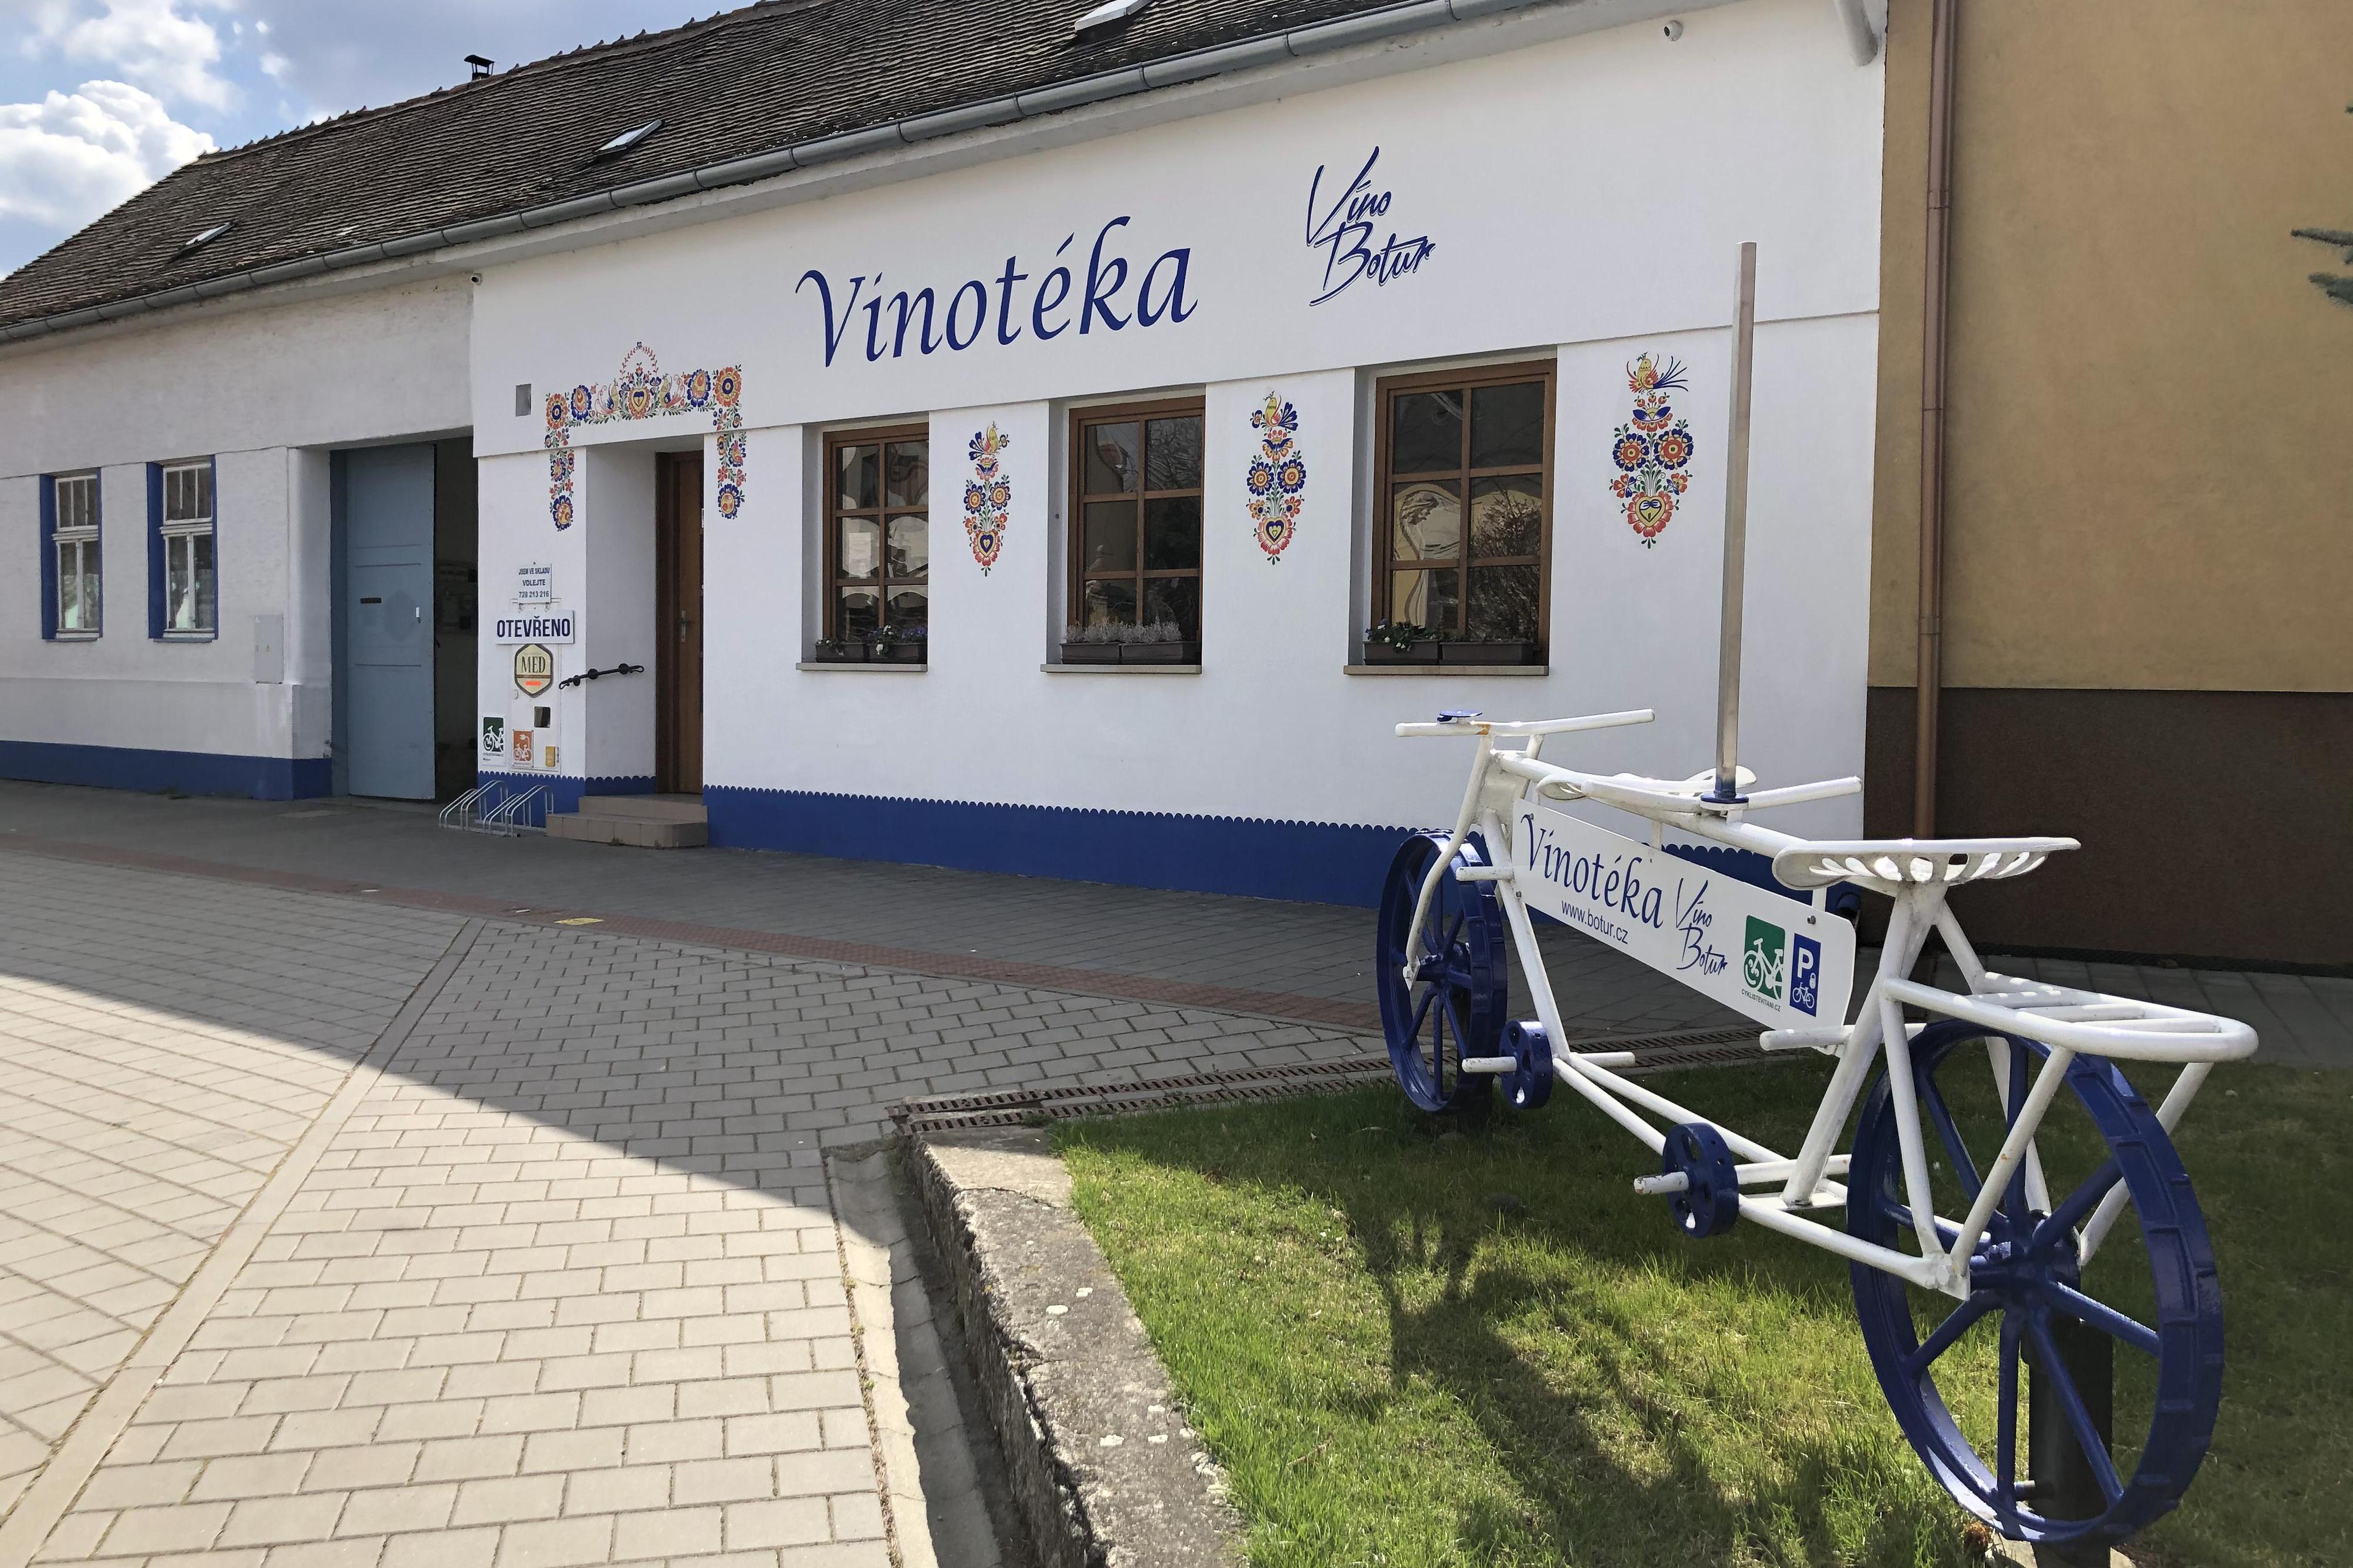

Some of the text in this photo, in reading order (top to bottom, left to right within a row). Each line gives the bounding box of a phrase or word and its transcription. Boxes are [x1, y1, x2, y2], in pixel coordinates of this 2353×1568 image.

[1306, 145, 1391, 247] Víno
[1307, 221, 1435, 306] Botur
[795, 216, 1198, 368] Vinotéka
[496, 615, 571, 638] OTEVŘENO
[521, 656, 546, 673] MED
[1521, 814, 1664, 929] Vinotéka
[1562, 900, 1628, 945] www.botur.cz
[1676, 878, 1712, 929] Víno
[1676, 922, 1728, 976] Botur
[1797, 947, 1814, 978] P
[1741, 988, 1782, 1012] CYKLISTEVITANI.CZ
